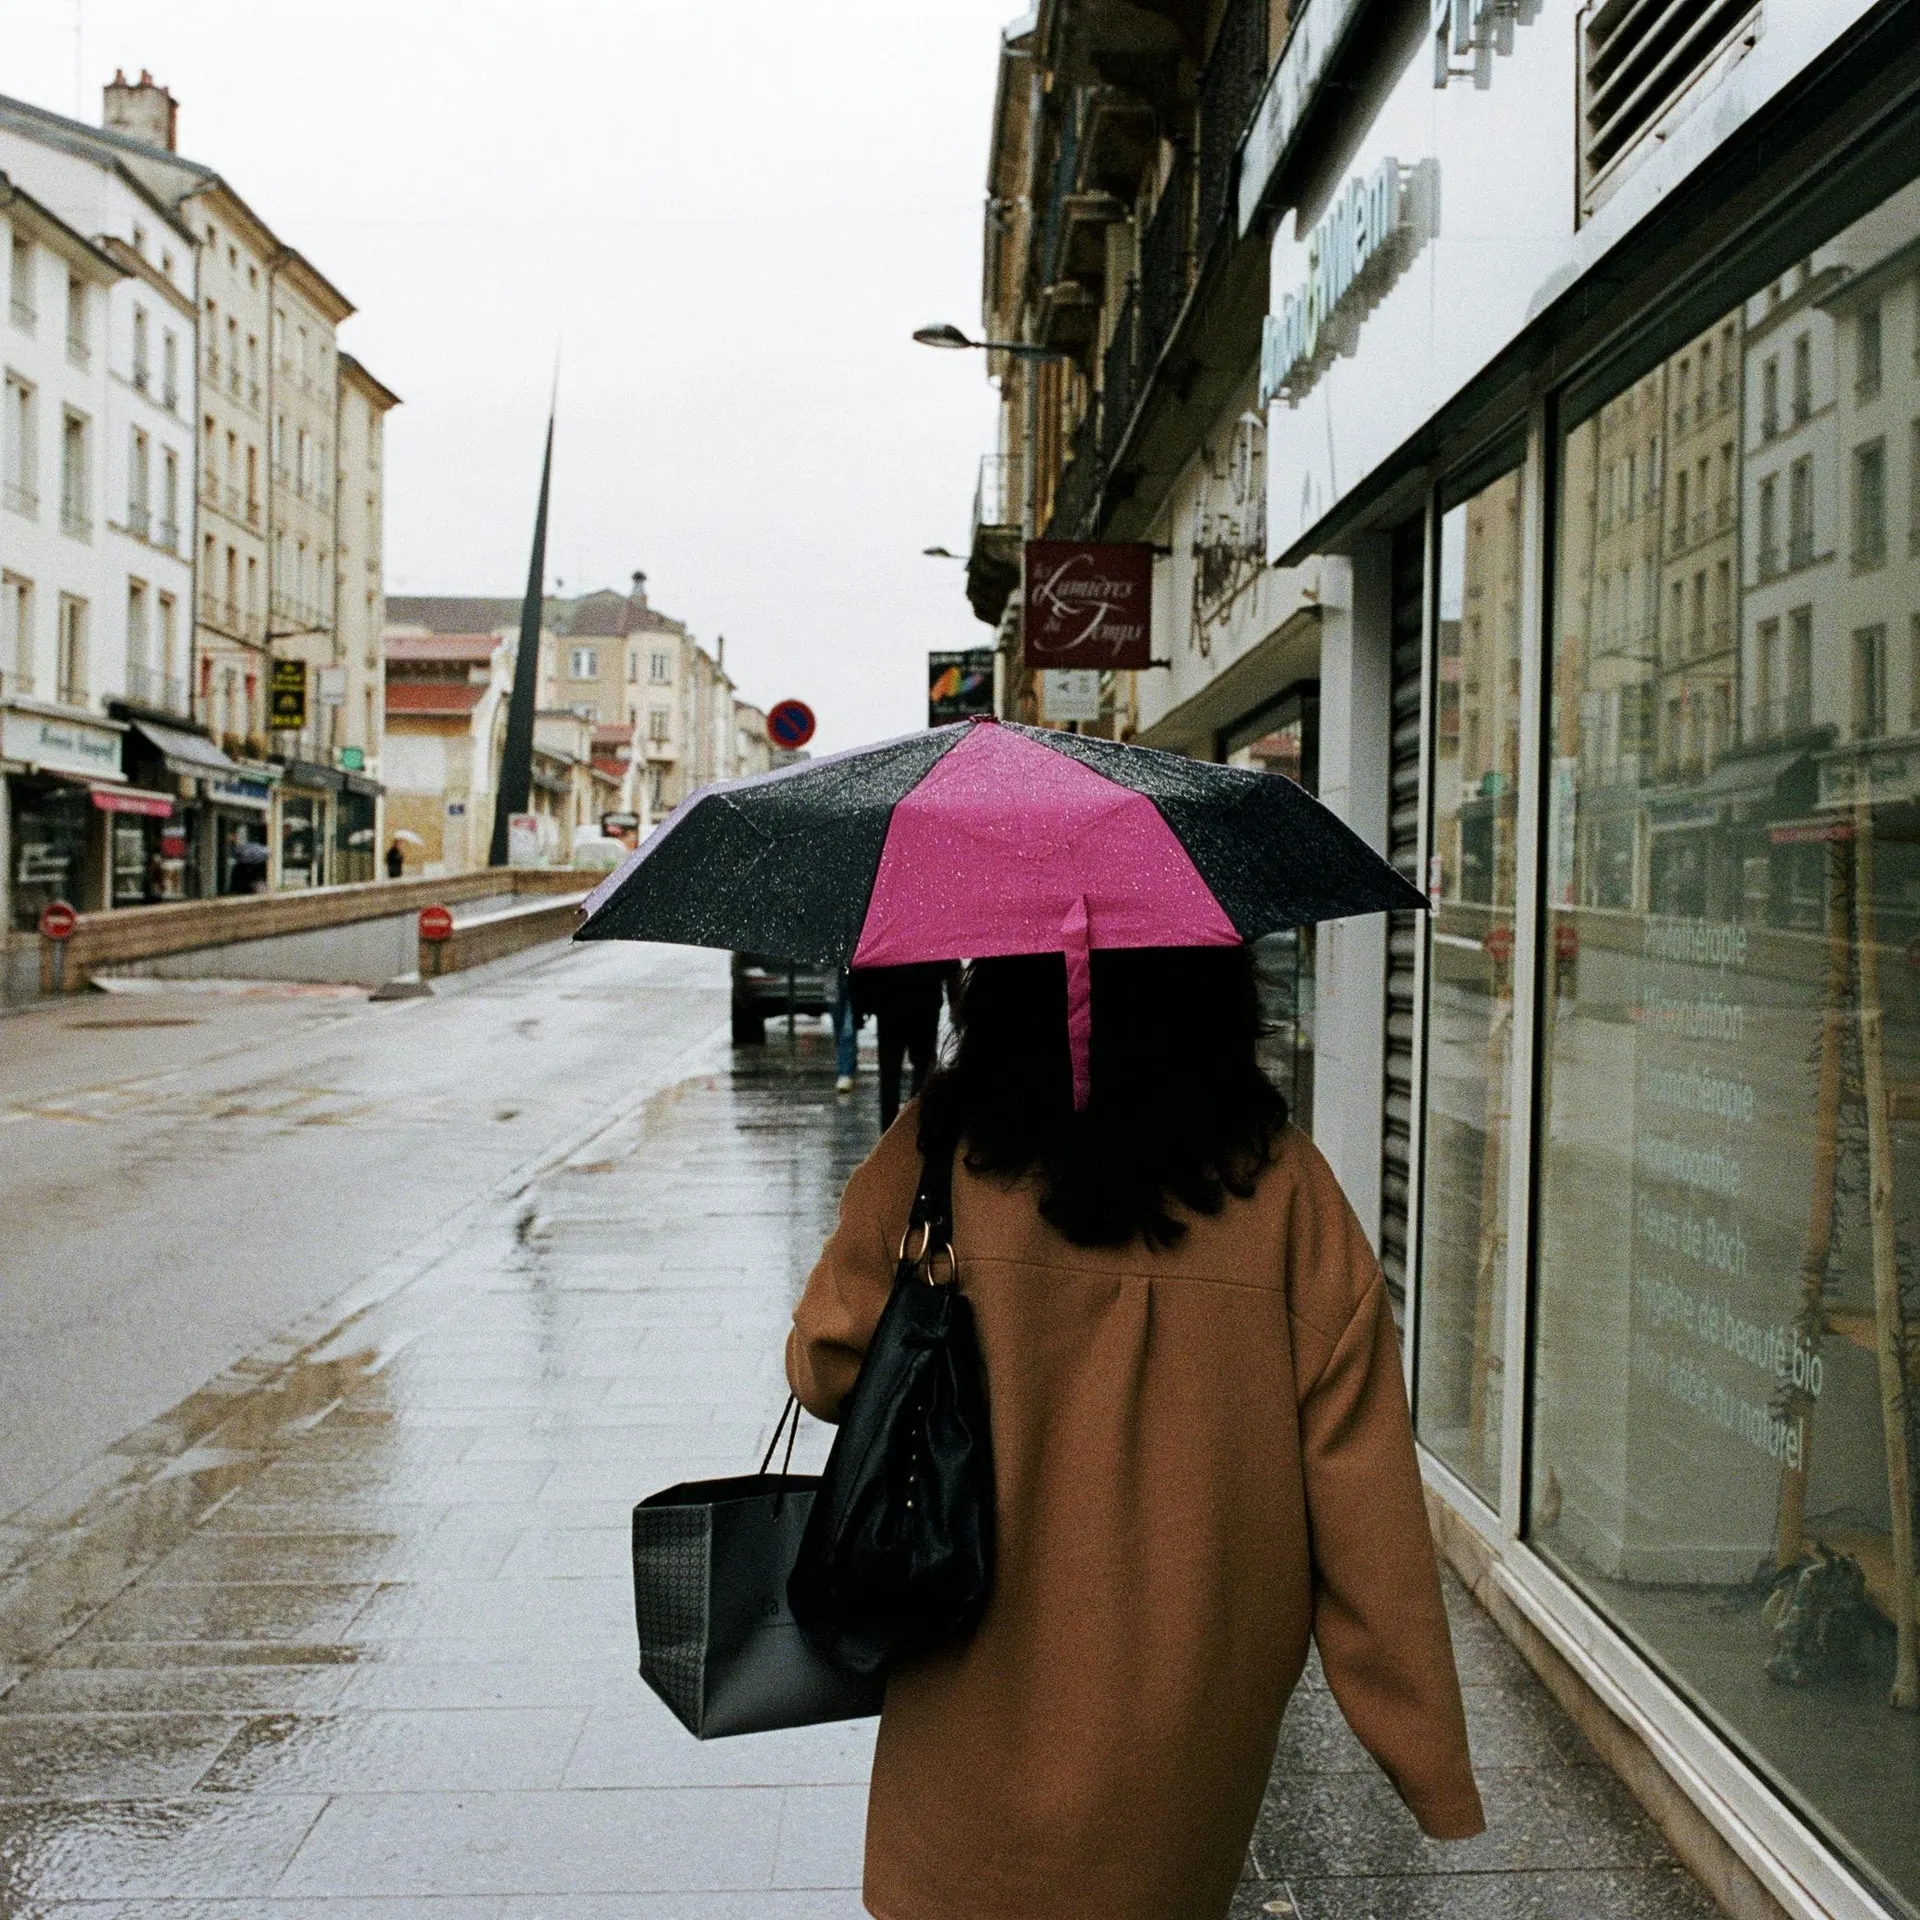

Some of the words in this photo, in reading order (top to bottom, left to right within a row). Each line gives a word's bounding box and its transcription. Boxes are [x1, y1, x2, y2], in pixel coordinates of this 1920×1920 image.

[1033, 599, 1143, 658] Temps
[1724, 1298, 1786, 1377] beauté
[1793, 1327, 1824, 1396] bio
